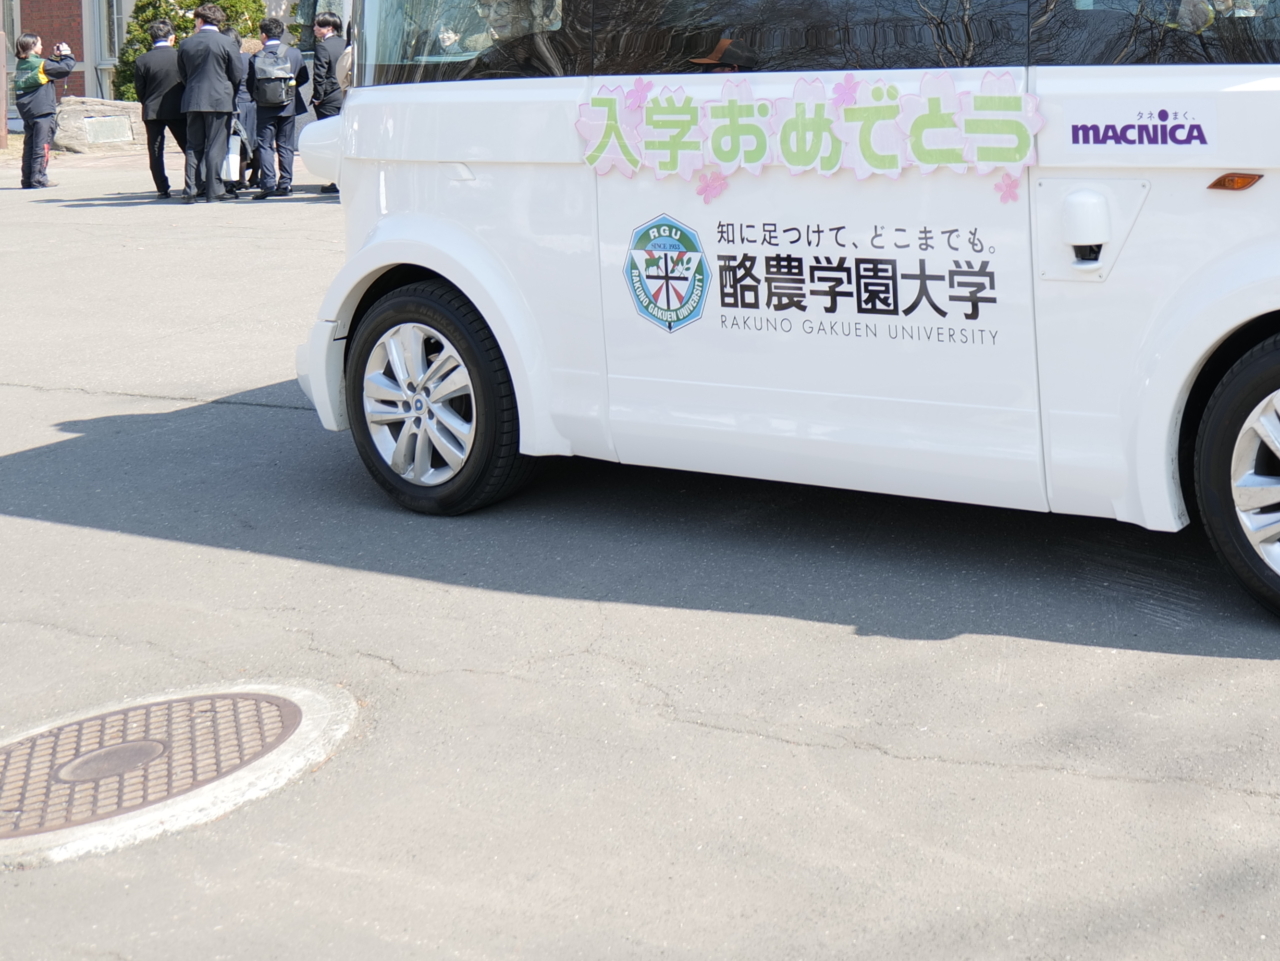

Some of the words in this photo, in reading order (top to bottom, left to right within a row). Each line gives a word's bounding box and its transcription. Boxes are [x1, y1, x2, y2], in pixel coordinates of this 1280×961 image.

[584, 85, 1032, 172] 入学おめでとう
[649, 226, 681, 240] RGU
[717, 220, 996, 255] 知に足つけて、どこまでも。
[631, 269, 649, 307] RAKUNO
[648, 303, 677, 321] GAKUEN
[676, 273, 703, 320] UNIVERSITY
[717, 253, 998, 320] 酪農学園大学
[720, 314, 793, 333] RAKUNO
[802, 319, 878, 338] GAKUEN
[888, 324, 999, 346] UNIVERSITY
